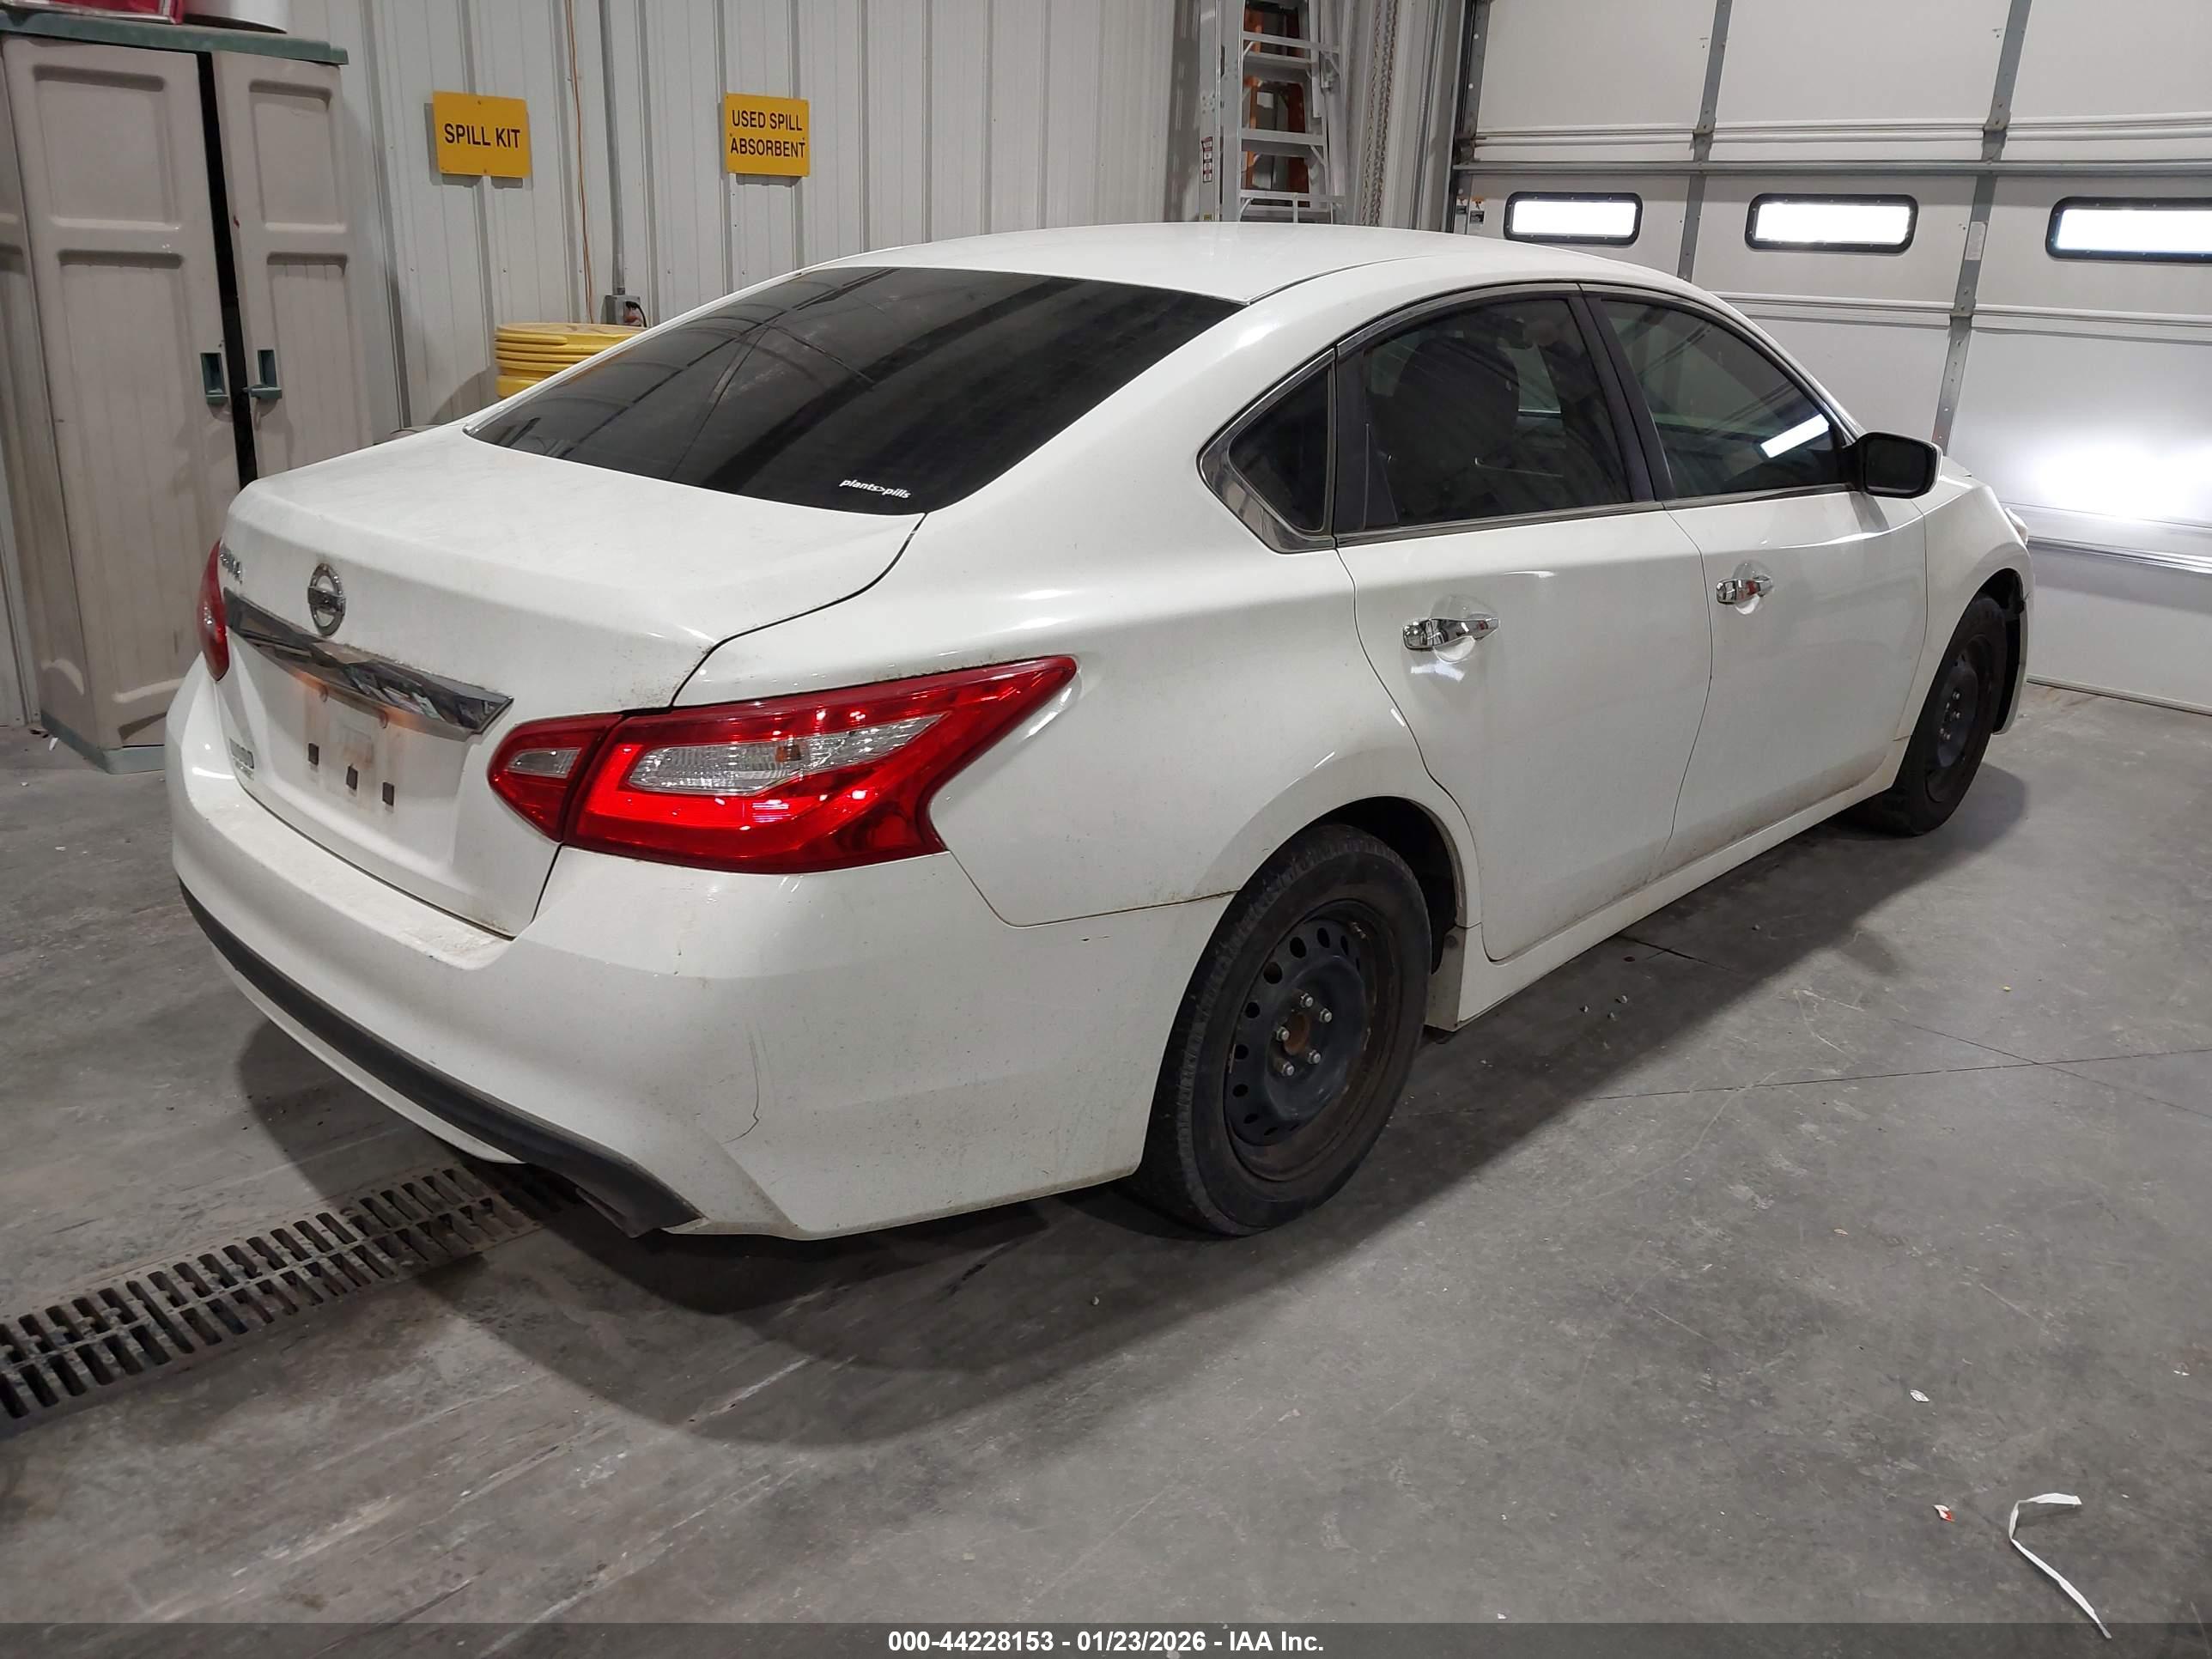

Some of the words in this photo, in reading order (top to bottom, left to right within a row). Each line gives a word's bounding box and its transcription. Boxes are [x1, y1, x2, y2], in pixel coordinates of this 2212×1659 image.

[732, 109, 766, 129] USED
[769, 112, 803, 131] SPILL
[444, 123, 491, 146] SPILL
[495, 127, 520, 149] KIT
[730, 137, 805, 158] ABSORBENT
[839, 479, 911, 499] plants>pills
